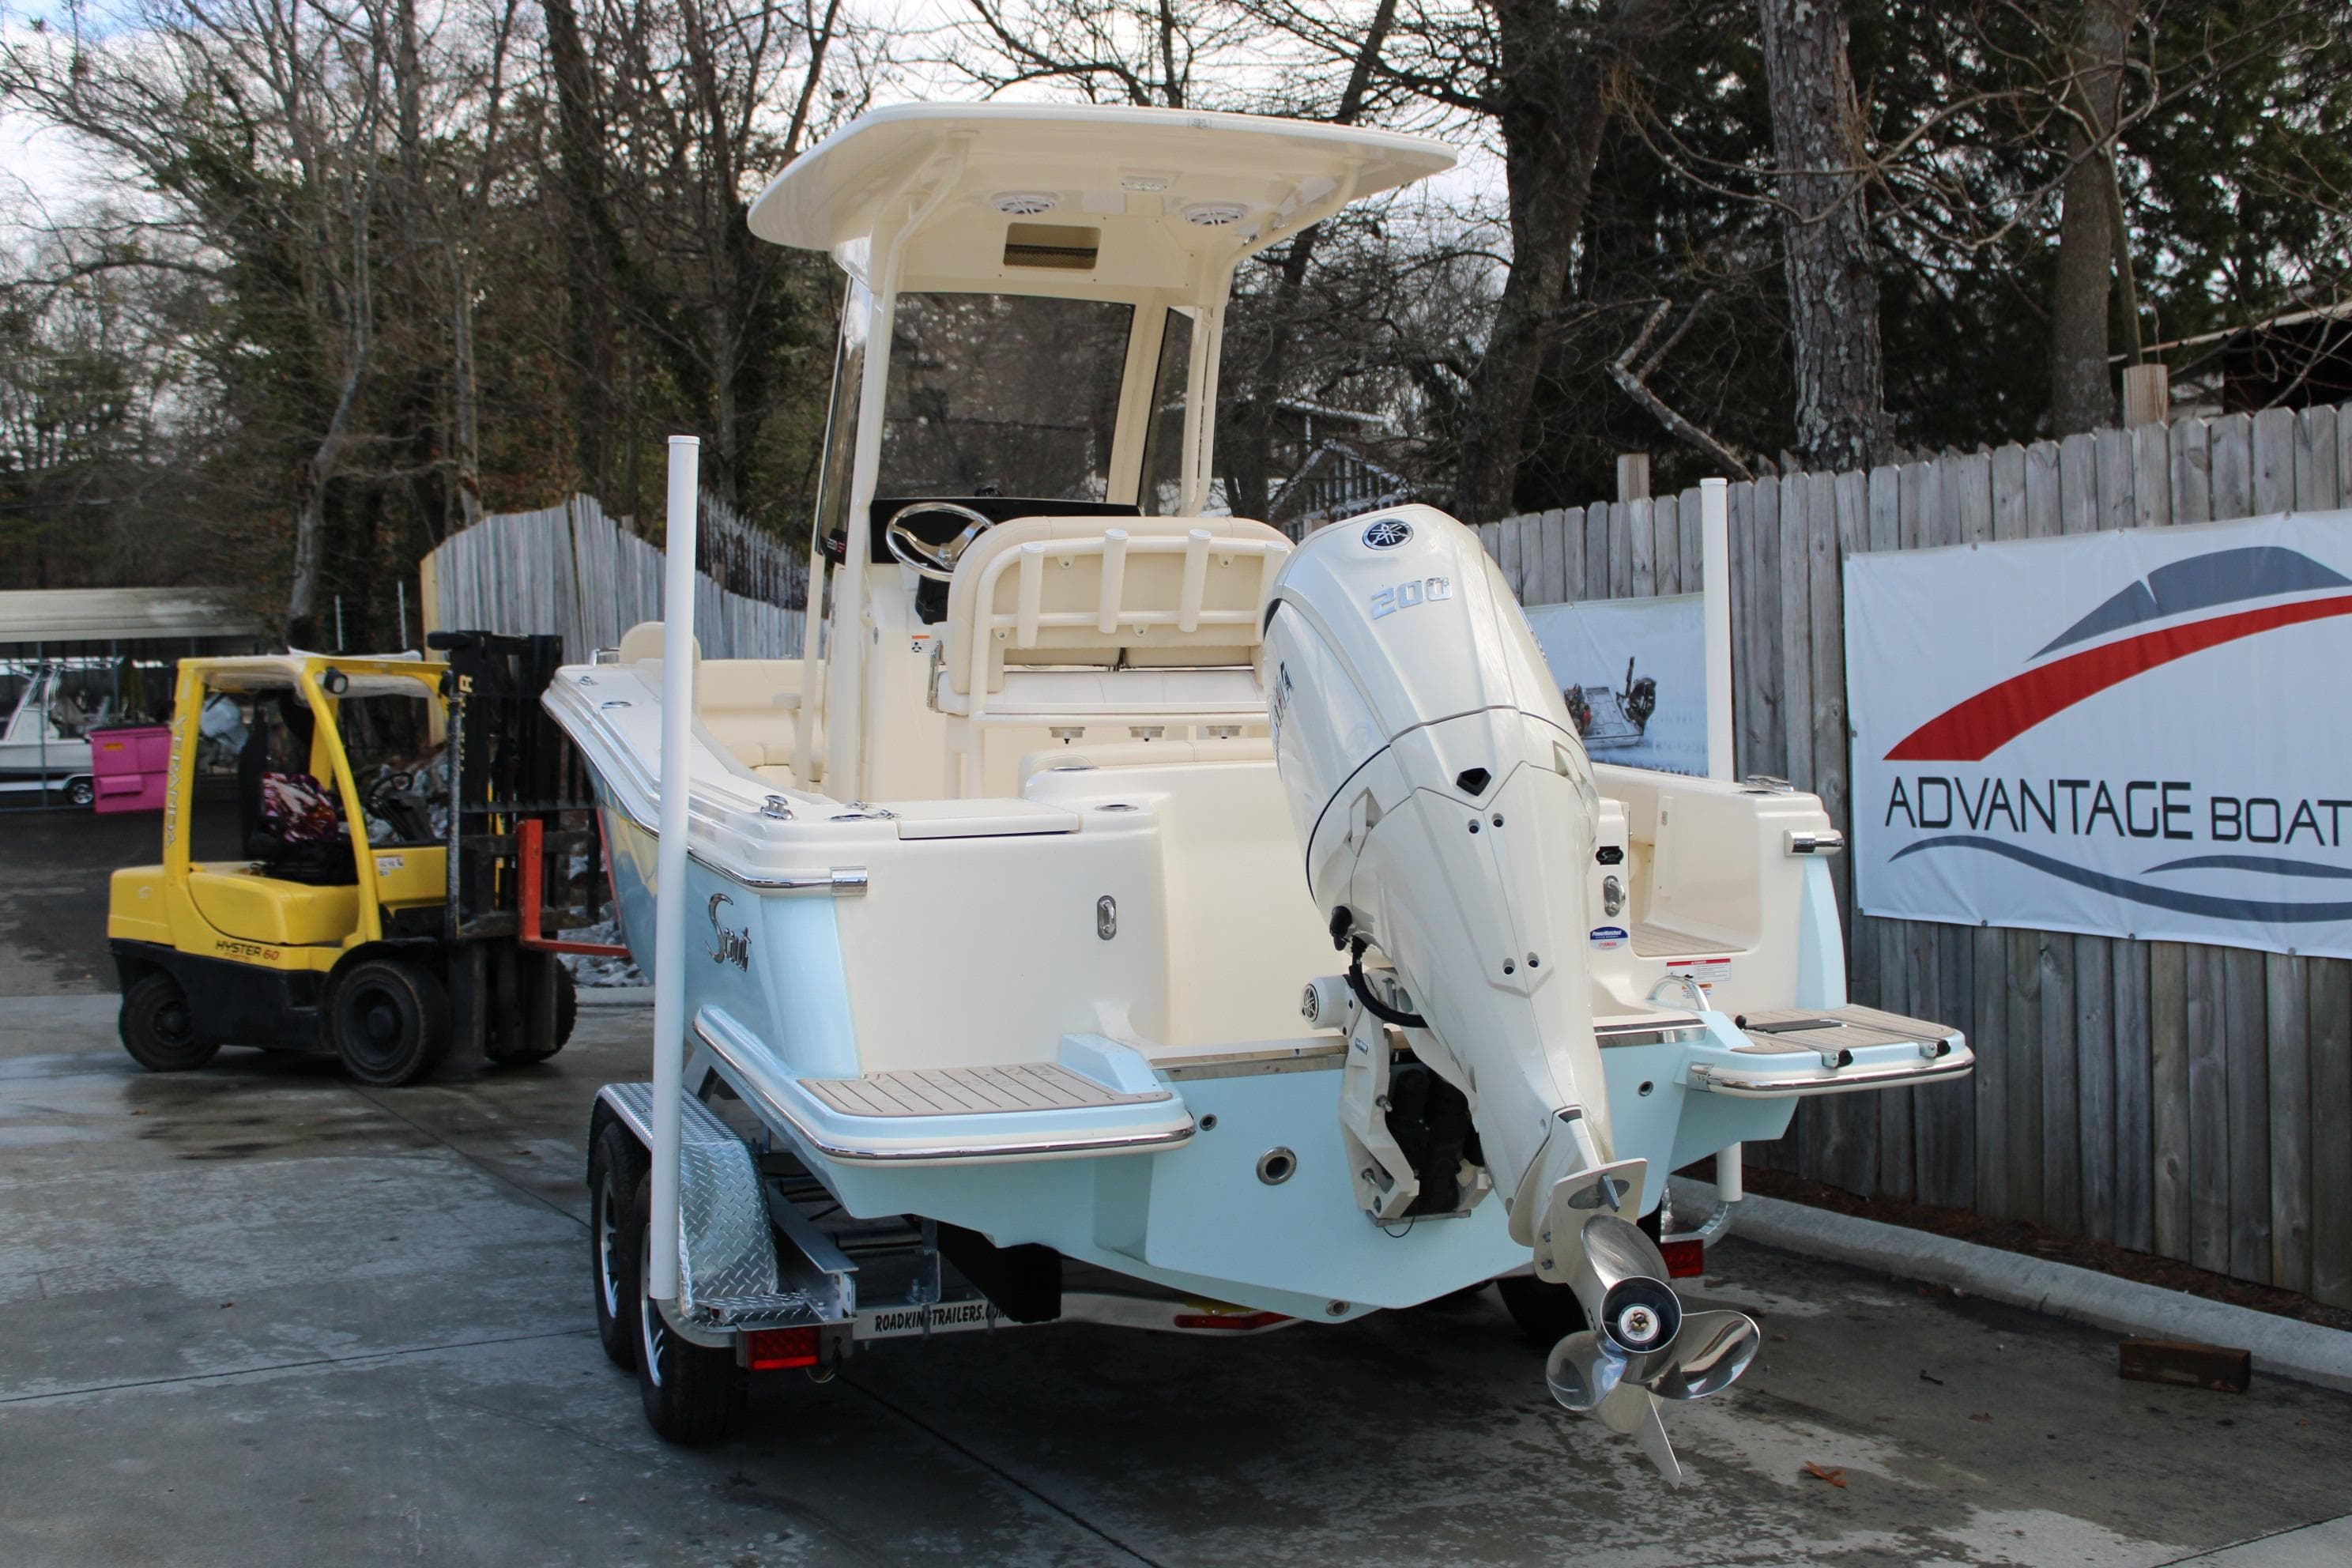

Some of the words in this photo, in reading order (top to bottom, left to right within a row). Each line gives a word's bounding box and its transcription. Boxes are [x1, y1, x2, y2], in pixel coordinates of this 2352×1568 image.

[1370, 577, 1453, 620] 200
[1885, 776, 2193, 840] ADVANTAGE
[2211, 796, 2352, 846] BOAT
[216, 940, 262, 957] HYSTER
[263, 949, 281, 960] 60
